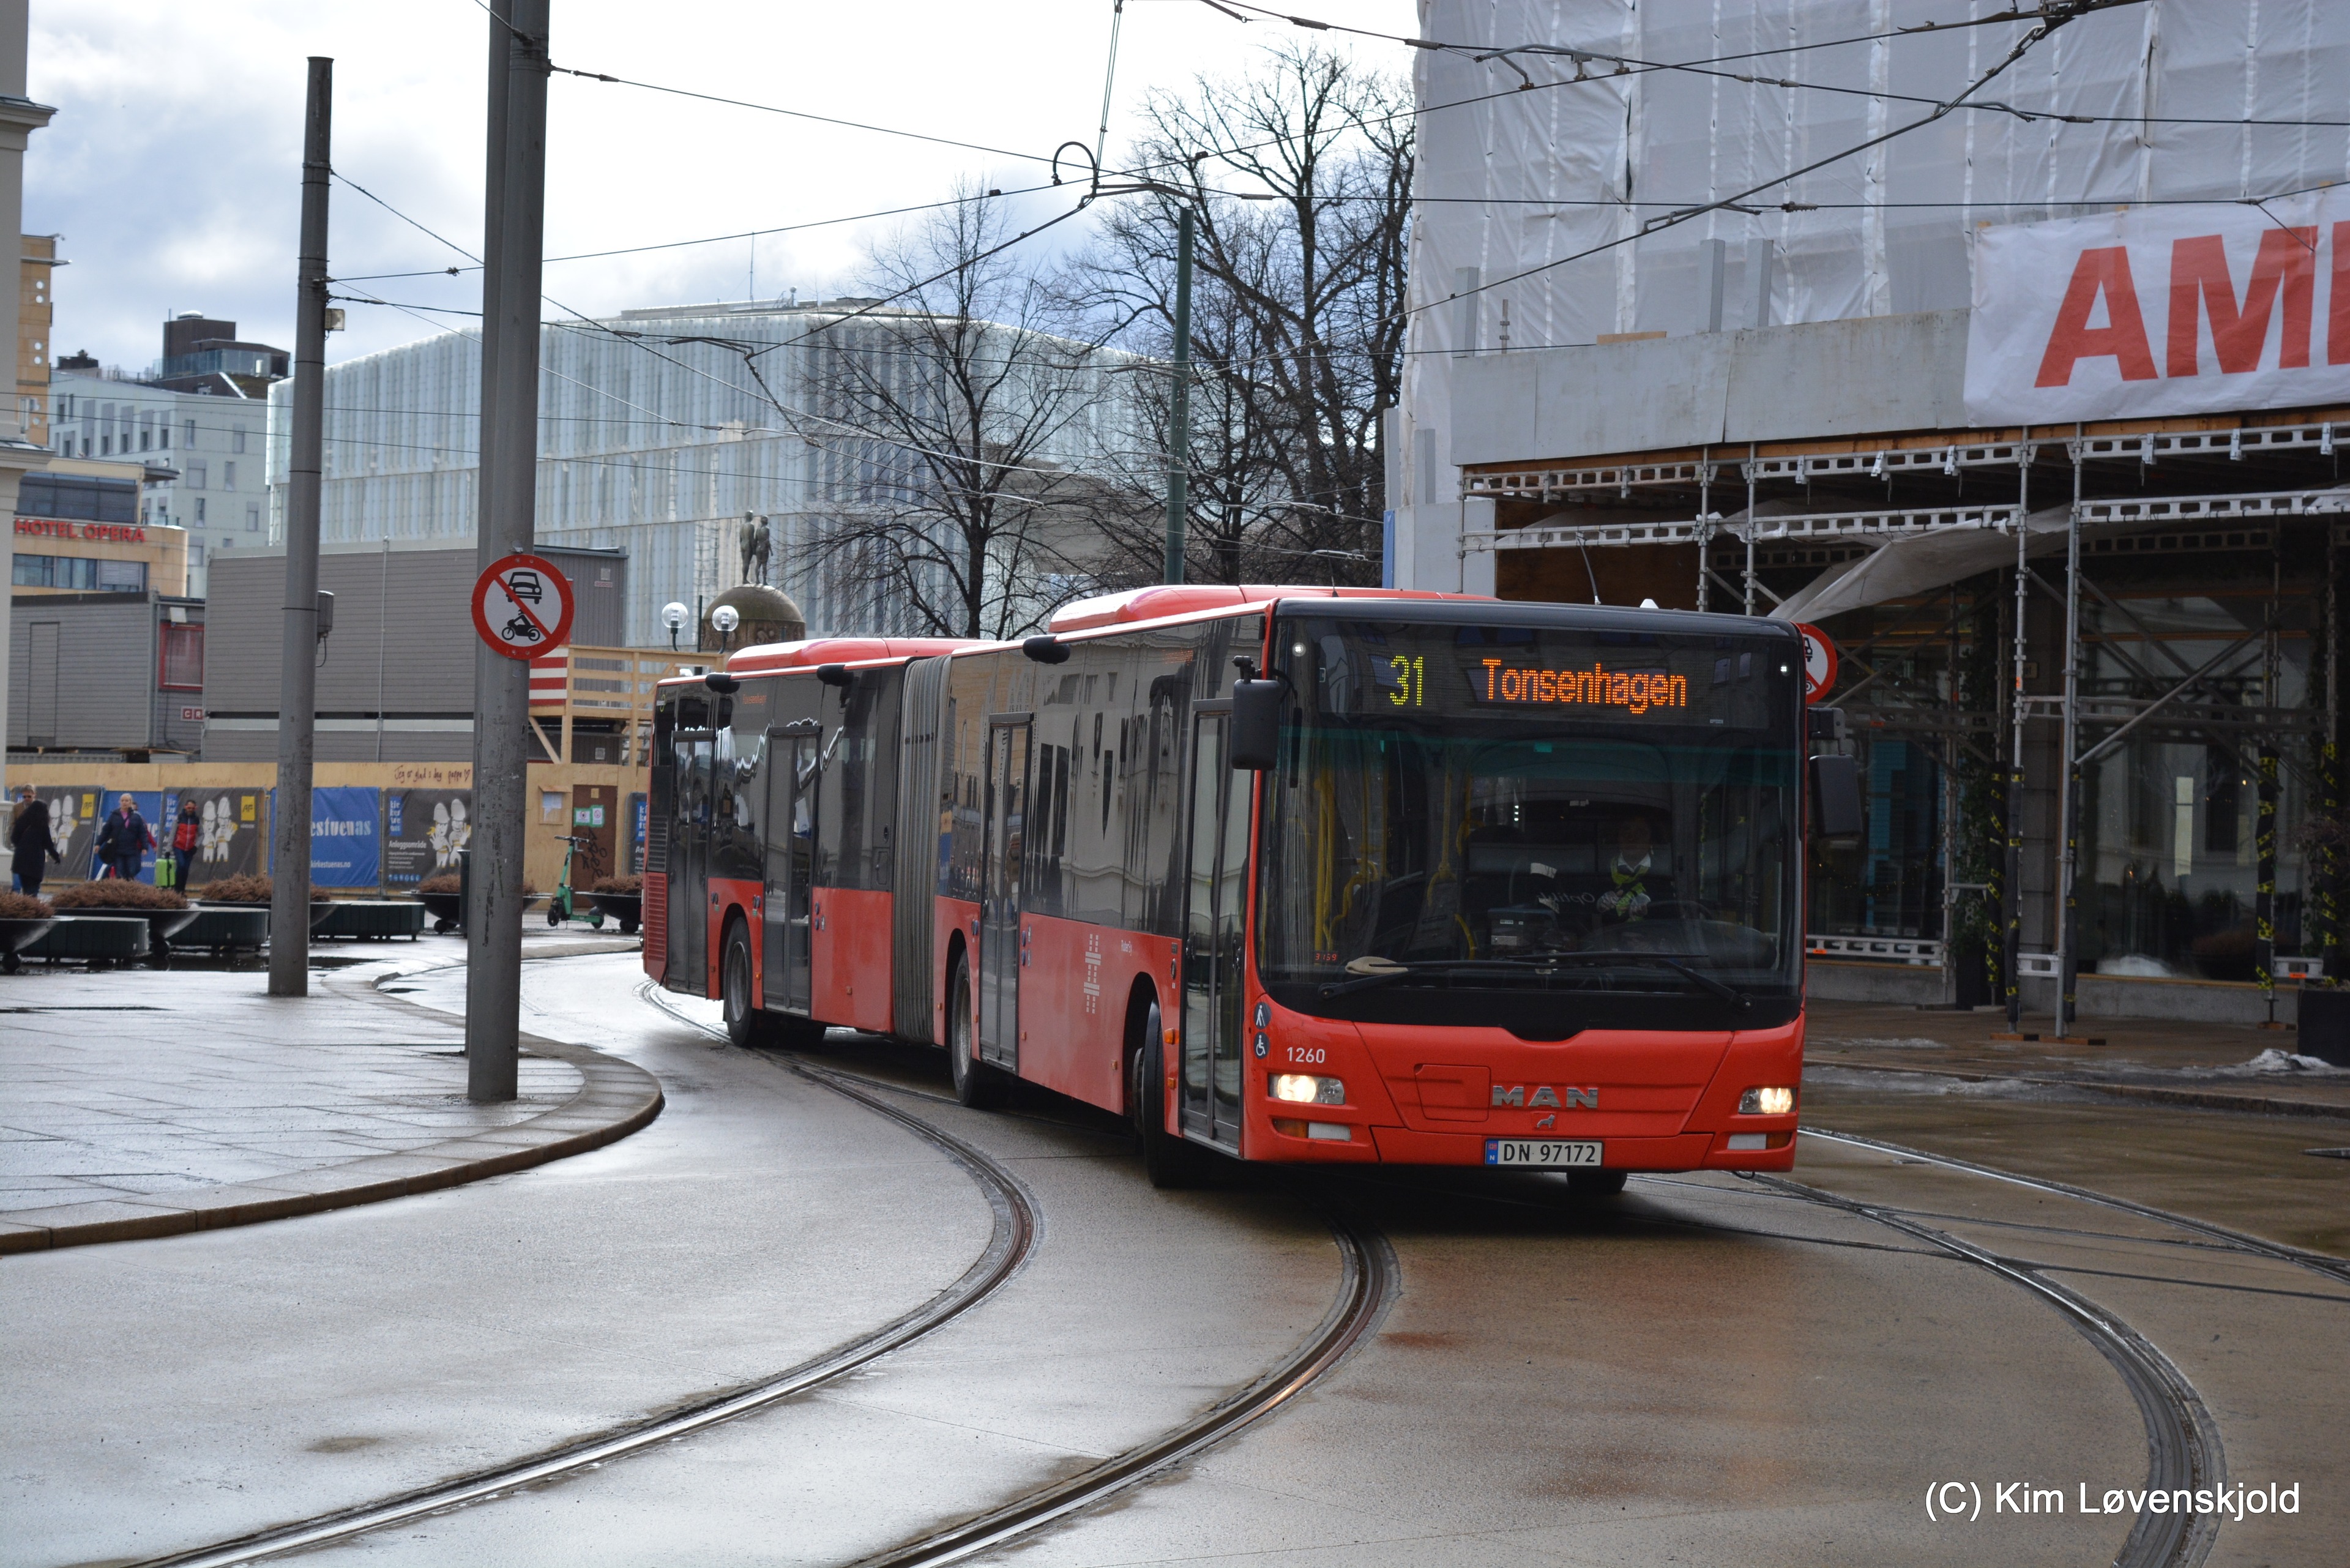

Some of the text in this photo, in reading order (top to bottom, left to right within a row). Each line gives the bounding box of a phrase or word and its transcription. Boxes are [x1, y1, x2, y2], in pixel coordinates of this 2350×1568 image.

[15, 518, 146, 543] HOTEL OPERA
[1390, 655, 1424, 706] 31
[1483, 659, 1687, 715] Tonsenhagen
[311, 817, 371, 837] estuenas
[1287, 1046, 1326, 1064] 1260
[1492, 1086, 1598, 1108] MAN
[1504, 1143, 1596, 1163] DN 97172
